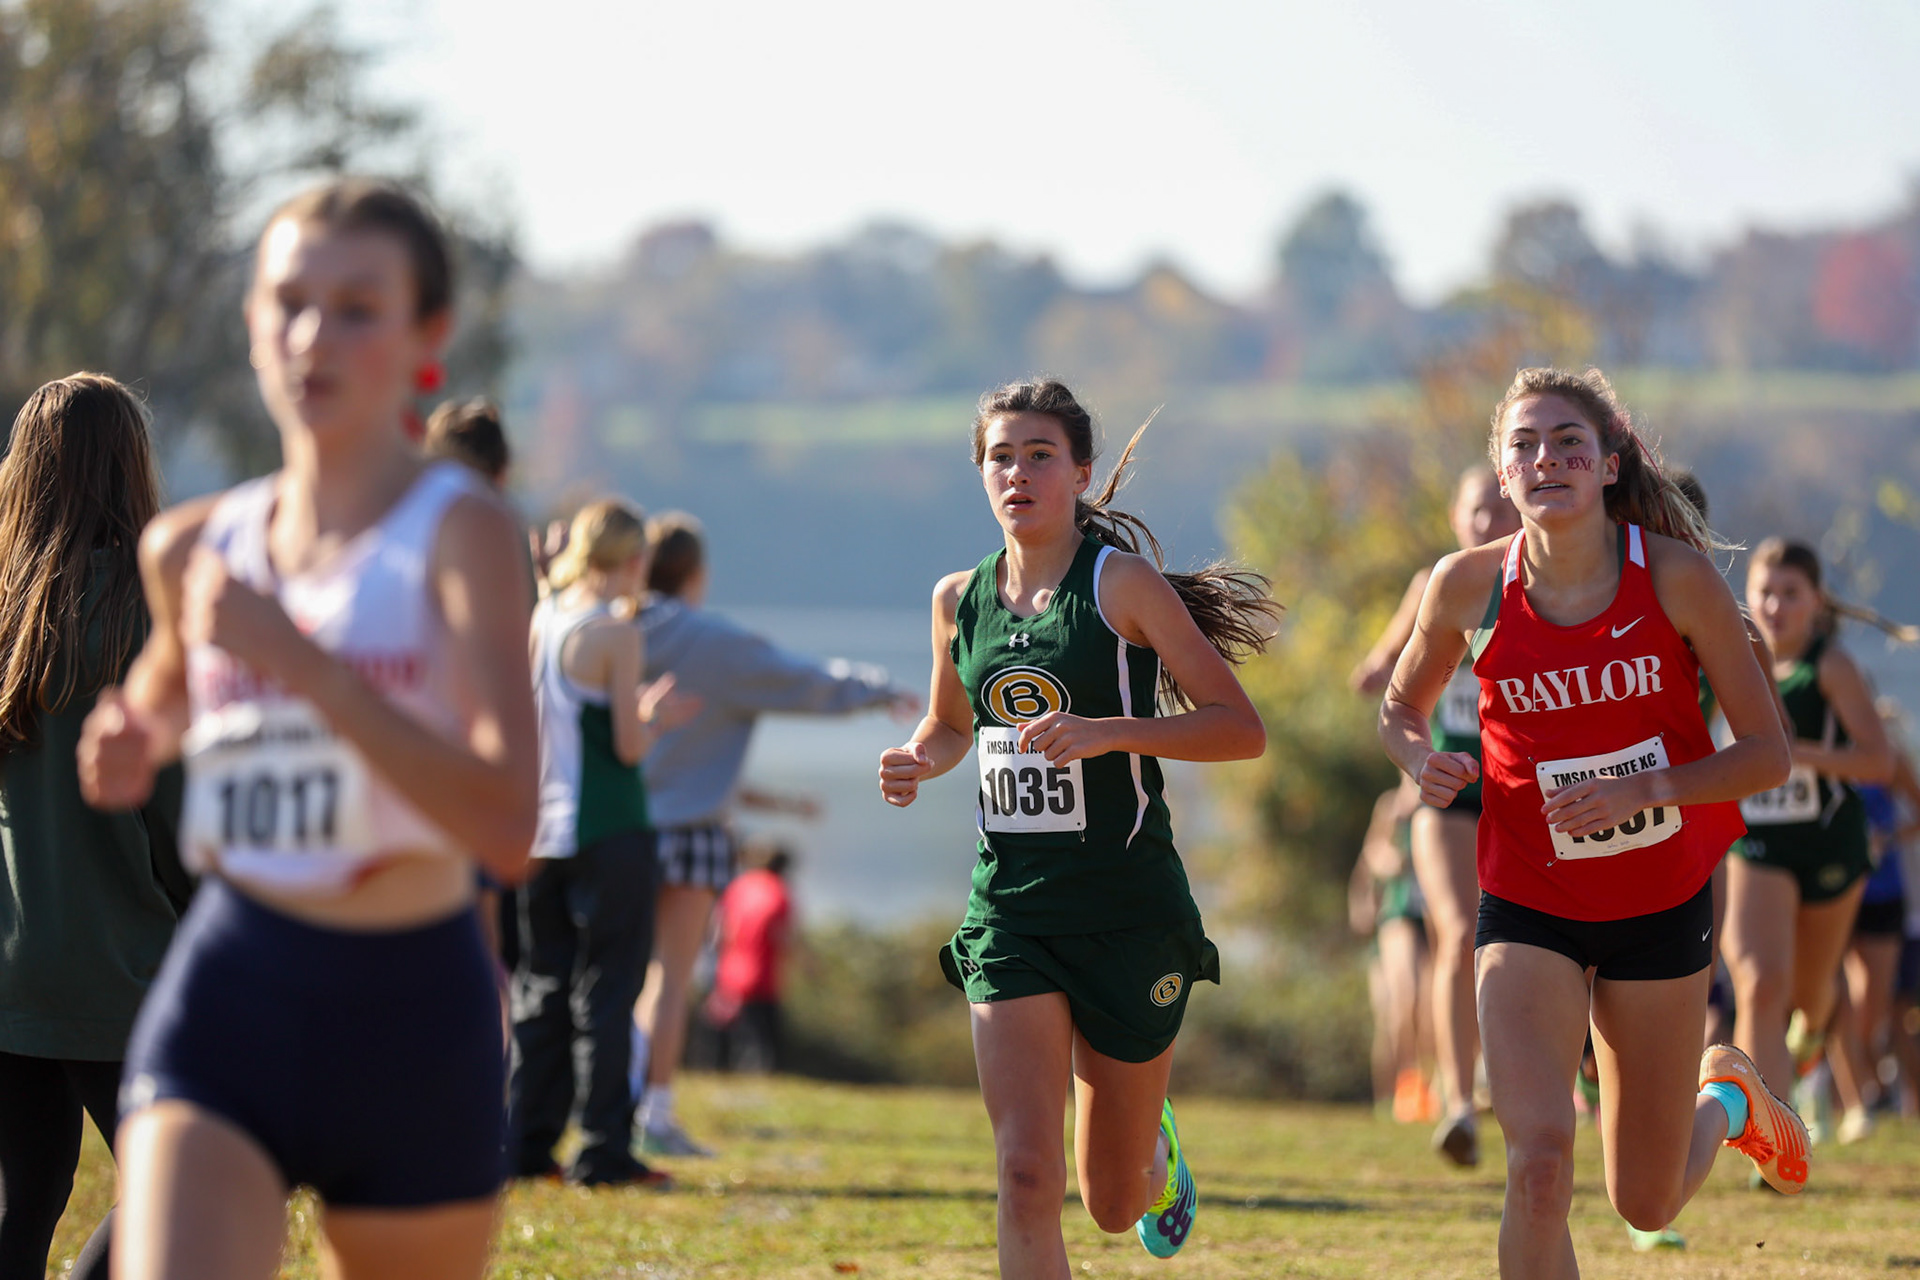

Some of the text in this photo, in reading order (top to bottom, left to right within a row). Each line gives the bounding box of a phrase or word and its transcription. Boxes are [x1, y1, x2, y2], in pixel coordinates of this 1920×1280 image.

[1565, 456, 1595, 473] BXC
[1496, 655, 1663, 713] BAYLOR
[986, 740, 1015, 754] TMSAA
[1552, 752, 1657, 787] TMSAA STATE XC
[220, 767, 338, 848] 1017
[985, 766, 1075, 817] 1035
